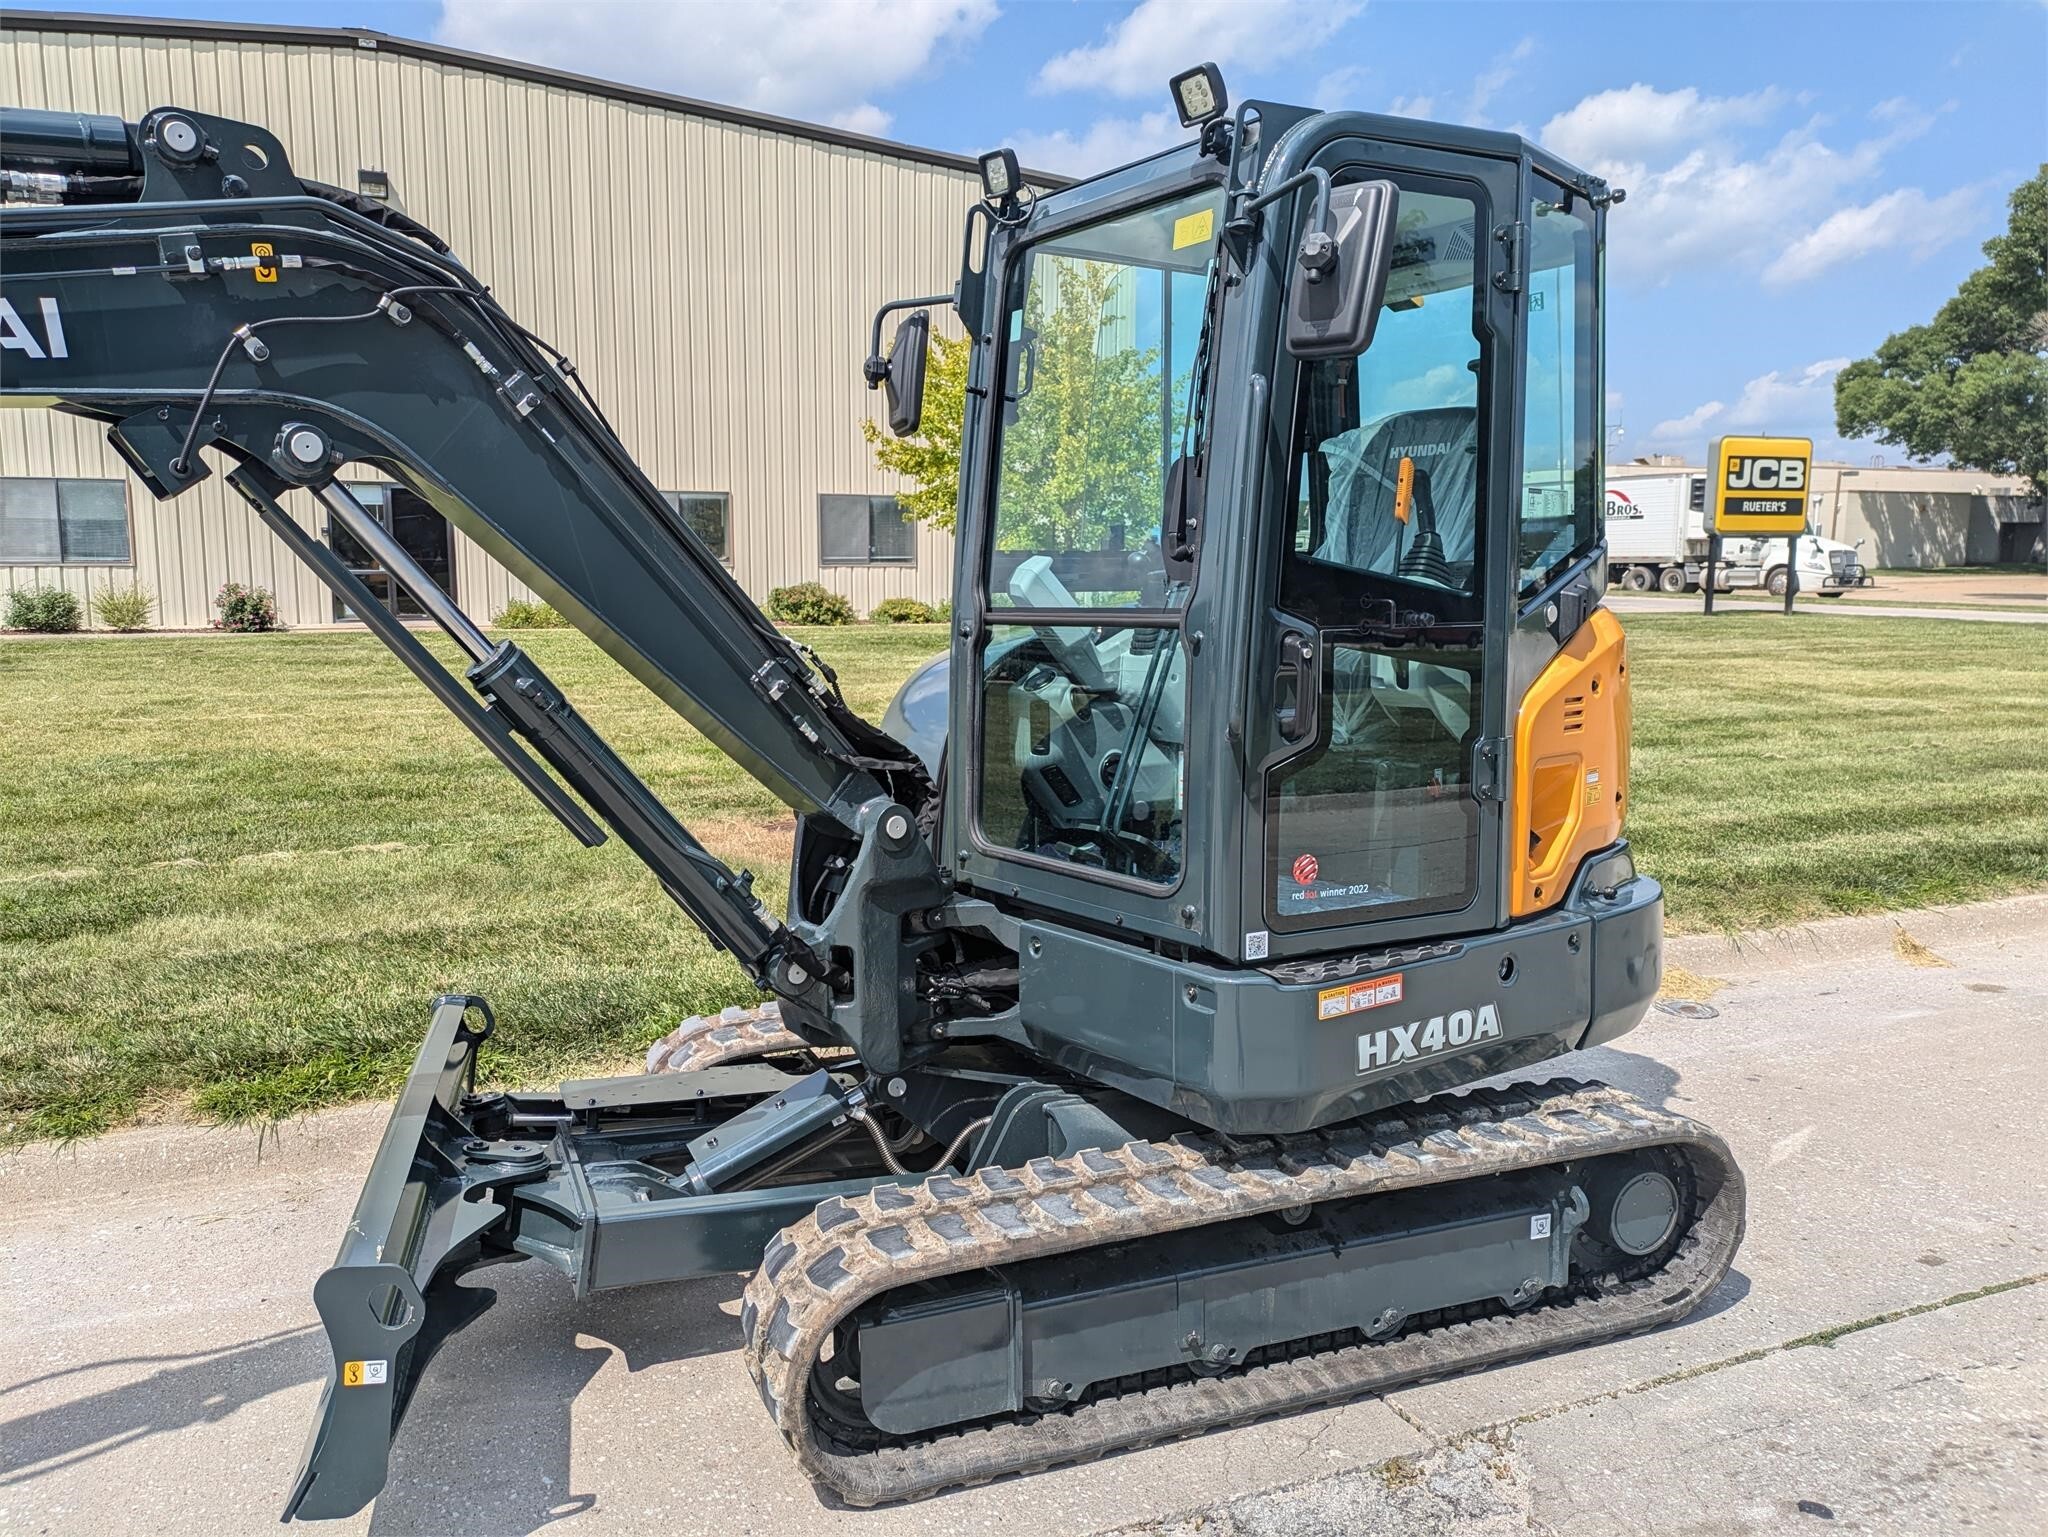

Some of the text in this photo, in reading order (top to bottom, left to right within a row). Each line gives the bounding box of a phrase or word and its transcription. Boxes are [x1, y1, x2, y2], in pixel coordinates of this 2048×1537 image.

[1390, 442, 1451, 459] HYUNDAI
[1728, 458, 1804, 488] JCB
[1742, 501, 1787, 512] RUETER'S
[1320, 887, 1347, 898] winner
[1348, 883, 1369, 895] 2022
[1358, 1004, 1500, 1070] HX40A
